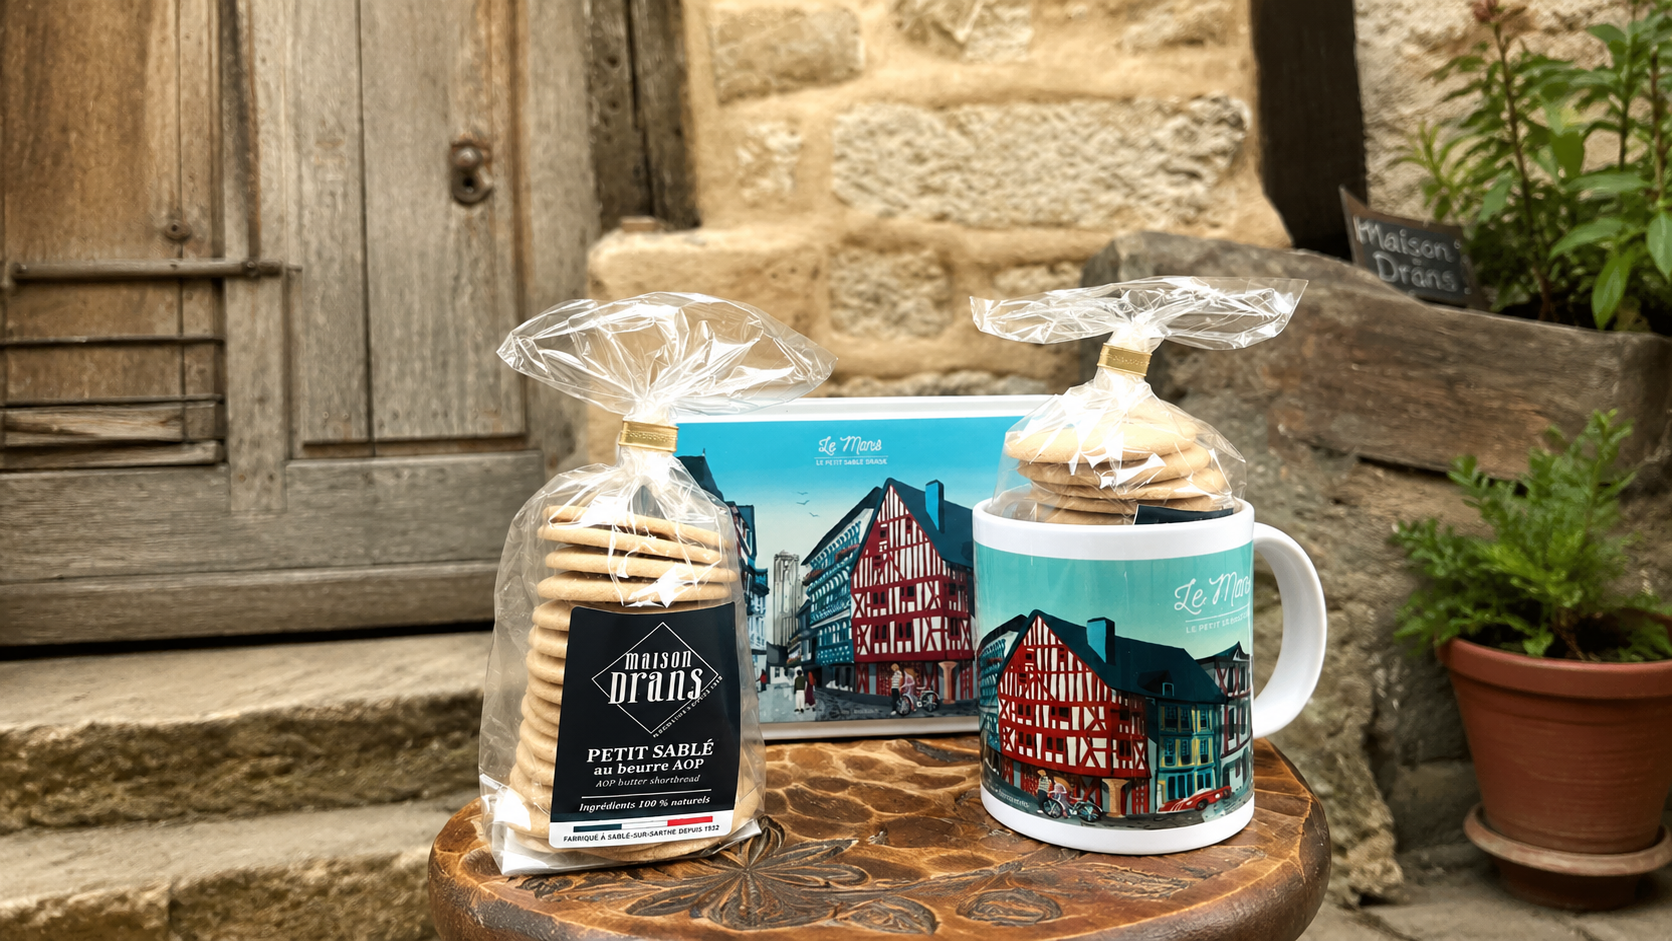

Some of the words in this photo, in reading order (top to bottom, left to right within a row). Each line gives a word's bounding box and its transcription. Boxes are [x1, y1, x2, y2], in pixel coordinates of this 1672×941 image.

[1353, 215, 1454, 263] Maison
[1372, 251, 1458, 292] Drans
[818, 436, 836, 456] Le
[840, 435, 882, 455] Mans
[1174, 578, 1207, 615] Le
[1186, 625, 1197, 634] LE
[1199, 621, 1221, 632] PETIT
[586, 746, 648, 763] PETIT
[652, 738, 715, 759] SABLÉ
[593, 765, 613, 776] au
[617, 761, 669, 775] beurre
[672, 758, 704, 771] AOP
[595, 779, 616, 788] AOP
[618, 776, 647, 787] butter
[649, 774, 701, 785] shortbread
[579, 800, 636, 813] Ingrédients
[638, 799, 657, 809] 100
[659, 798, 668, 807] %
[670, 795, 711, 807] naturels
